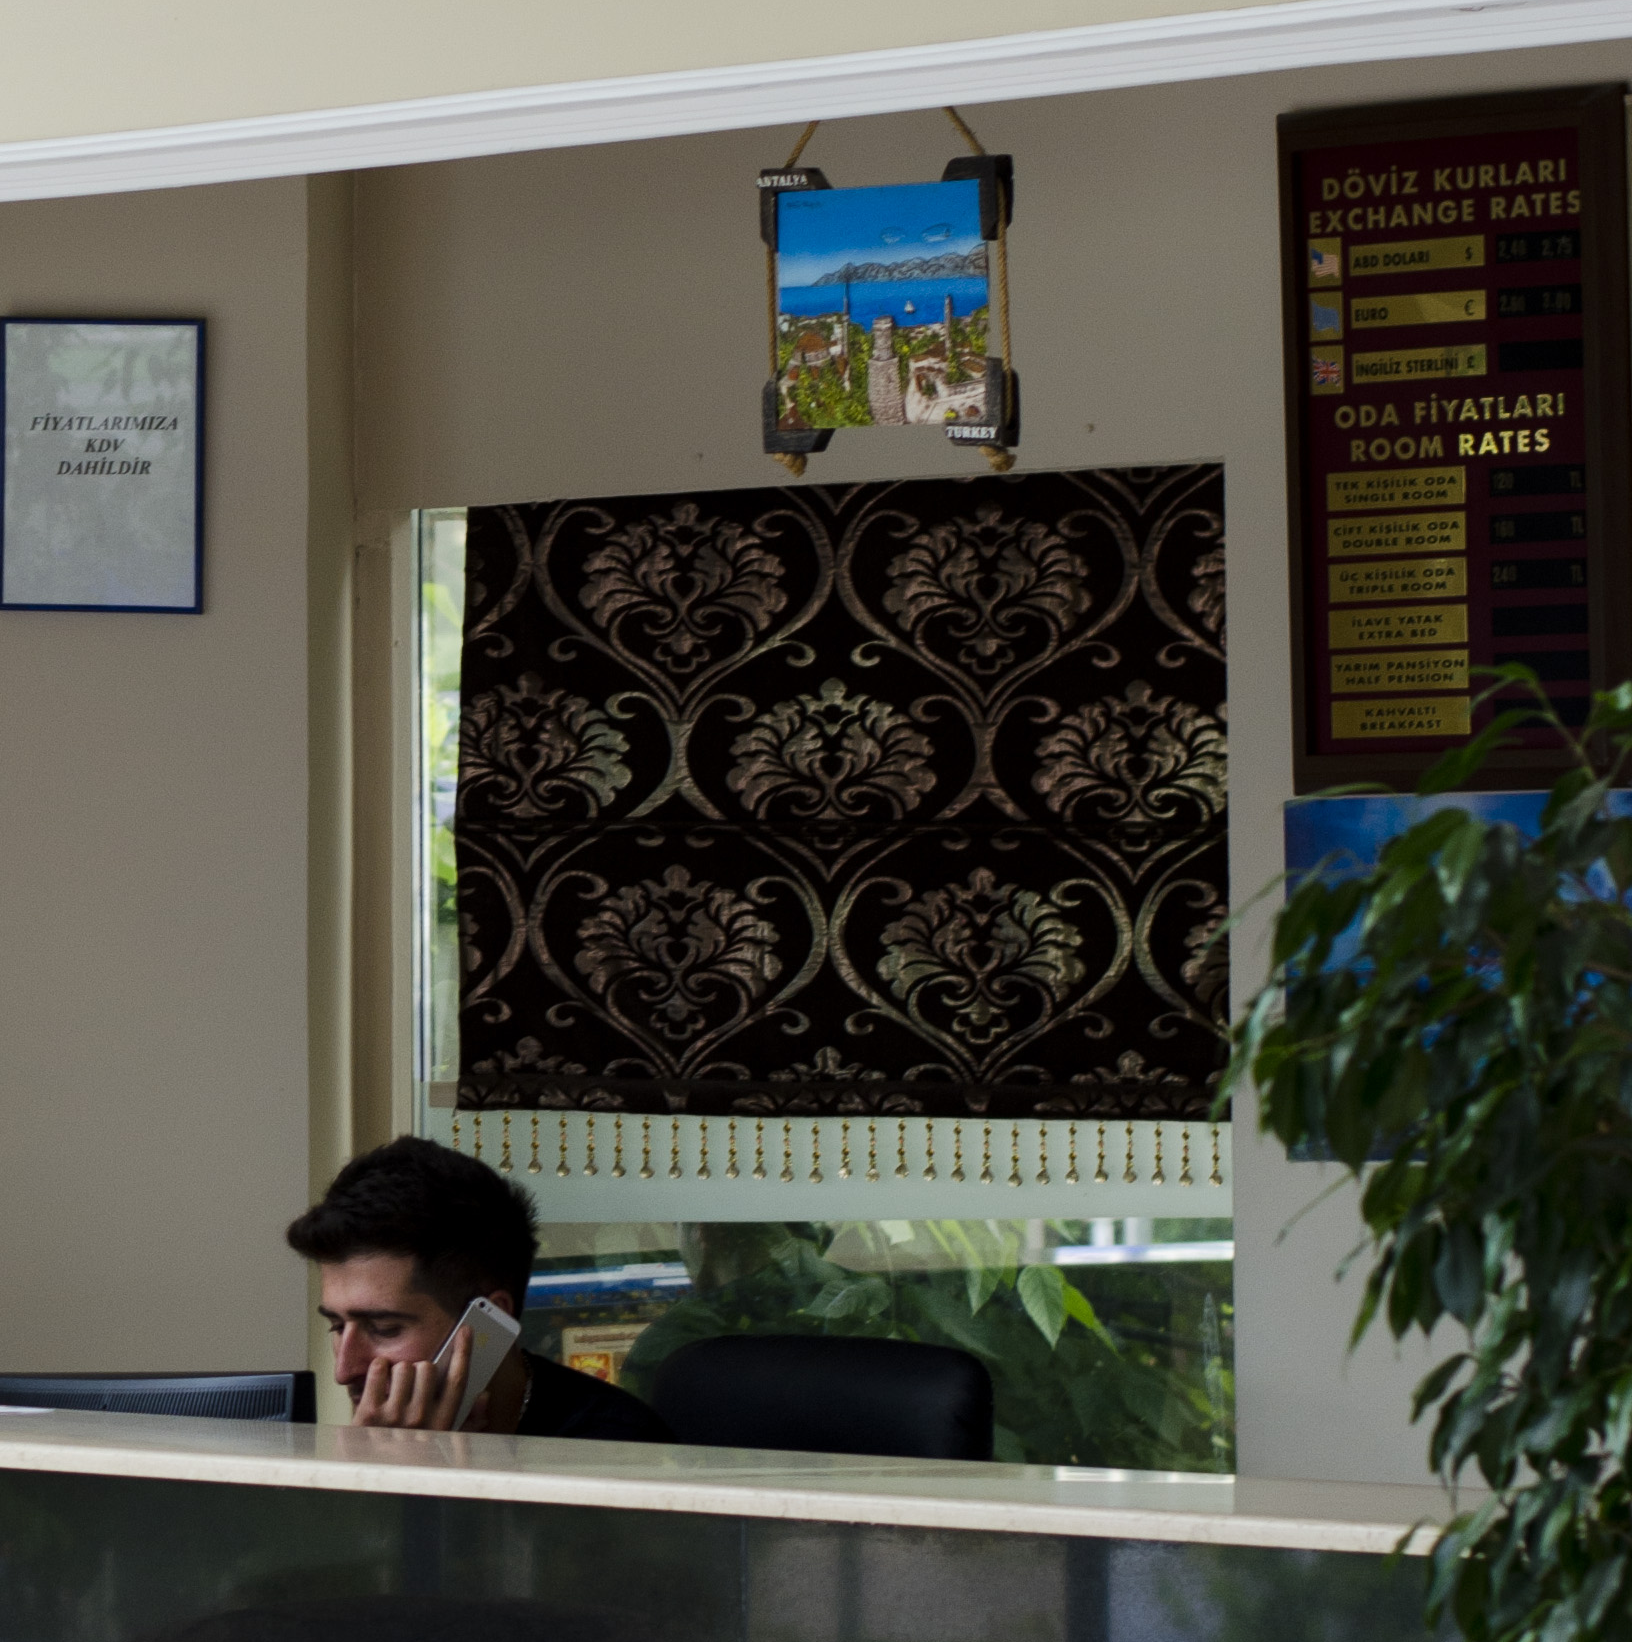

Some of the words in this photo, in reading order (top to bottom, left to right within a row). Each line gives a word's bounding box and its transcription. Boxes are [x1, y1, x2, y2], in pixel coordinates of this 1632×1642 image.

[756, 174, 808, 188] ANTALYA
[1321, 165, 1419, 202] DÖVİZ
[1433, 158, 1567, 192] KURLARI
[1308, 198, 1476, 235] EXCHANGE
[1489, 189, 1581, 220] RATES
[1354, 307, 1388, 322] EURO
[1334, 403, 1400, 429] ODA
[1413, 392, 1566, 425] FİYATLARI
[29, 412, 179, 431] FİYATLARIMIZA
[945, 426, 998, 439] TURKEY
[85, 438, 126, 453] KDV
[1349, 435, 1444, 463] ROOM
[1458, 428, 1551, 457] RATES
[56, 456, 152, 475] DAHİLDİR
[1424, 476, 1457, 487] ODA
[1344, 492, 1395, 503] SINGLE
[1402, 489, 1448, 501] ROOM
[1427, 521, 1460, 531] ODA
[1342, 537, 1399, 549] DOUBLE
[1405, 534, 1451, 545] ROOM
[1422, 567, 1456, 578] ODA
[1348, 583, 1395, 595] TRIPLE
[1400, 581, 1448, 592] ROOM
[1398, 614, 1443, 625] YATAK
[1358, 630, 1403, 641] EXTRA
[1410, 627, 1438, 638] BED
[1344, 674, 1382, 686] HALF
[1387, 672, 1454, 684] PENSION
[1365, 705, 1437, 718] KAHVALTI
[1360, 719, 1443, 732] BREAKFAST
